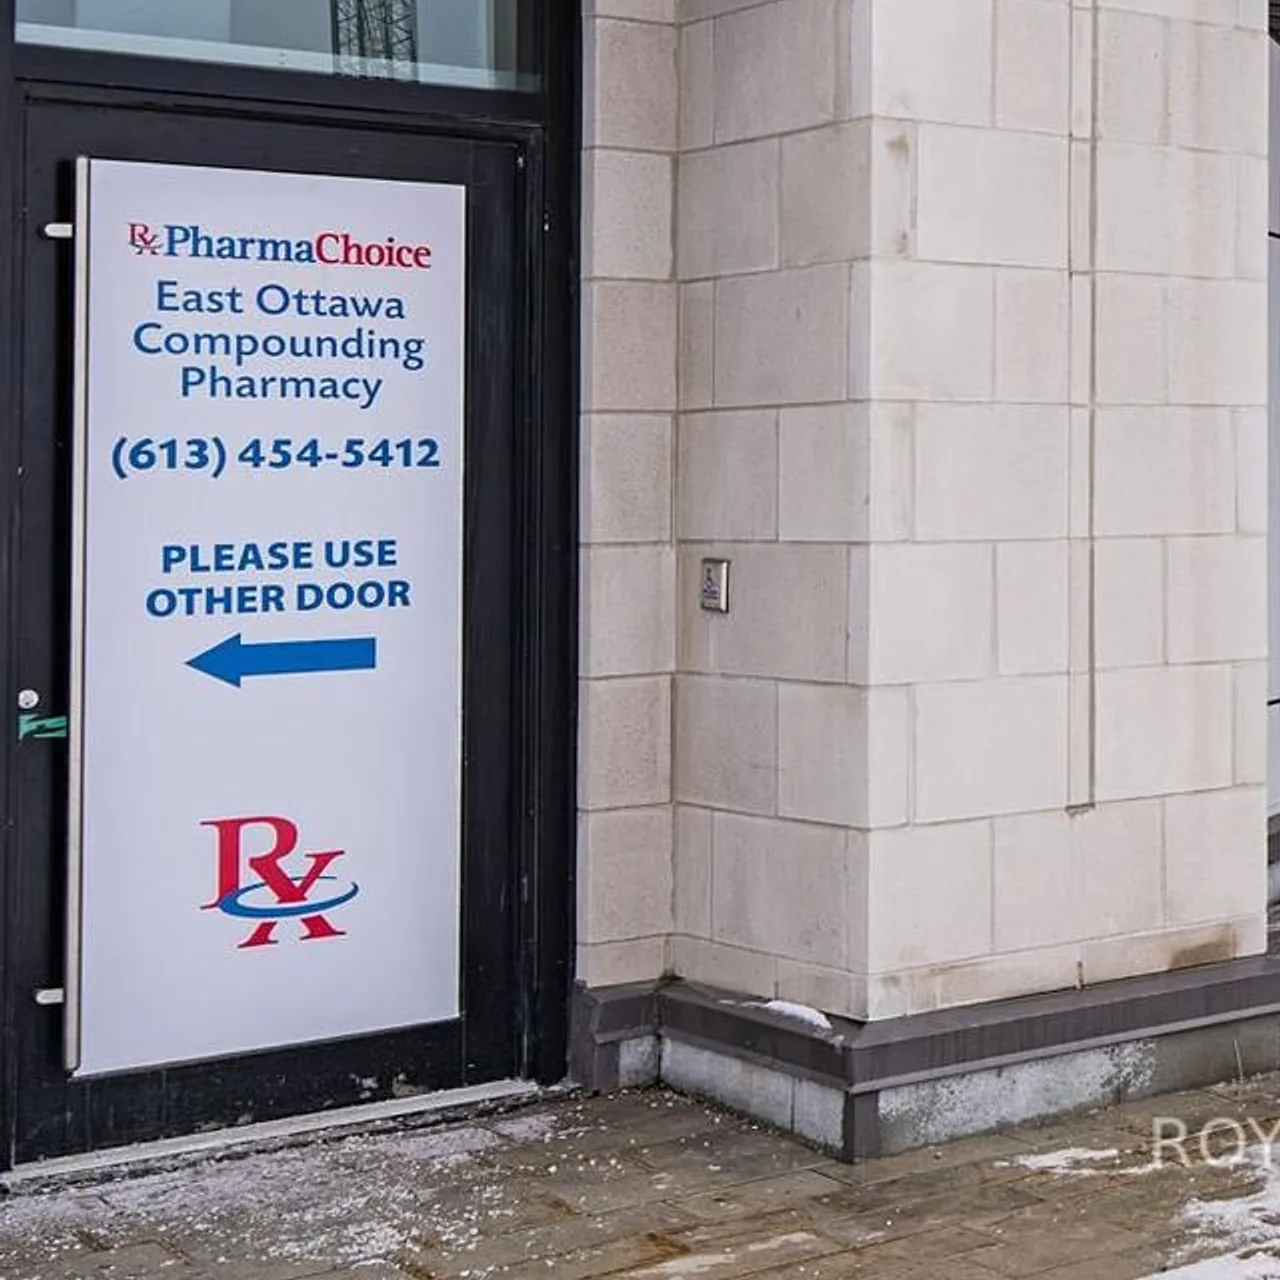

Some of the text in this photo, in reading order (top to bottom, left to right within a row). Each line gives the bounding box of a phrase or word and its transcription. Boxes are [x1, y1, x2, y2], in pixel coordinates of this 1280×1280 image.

[164, 225, 432, 269] PharmaChoice
[157, 280, 406, 320] East Ottawa
[133, 323, 425, 371] Compounding
[181, 367, 382, 410] Pharmacy
[112, 437, 440, 479] (613) 454-5412
[162, 539, 398, 573] PLEASE USE
[145, 580, 412, 617] OTHER DOOR
